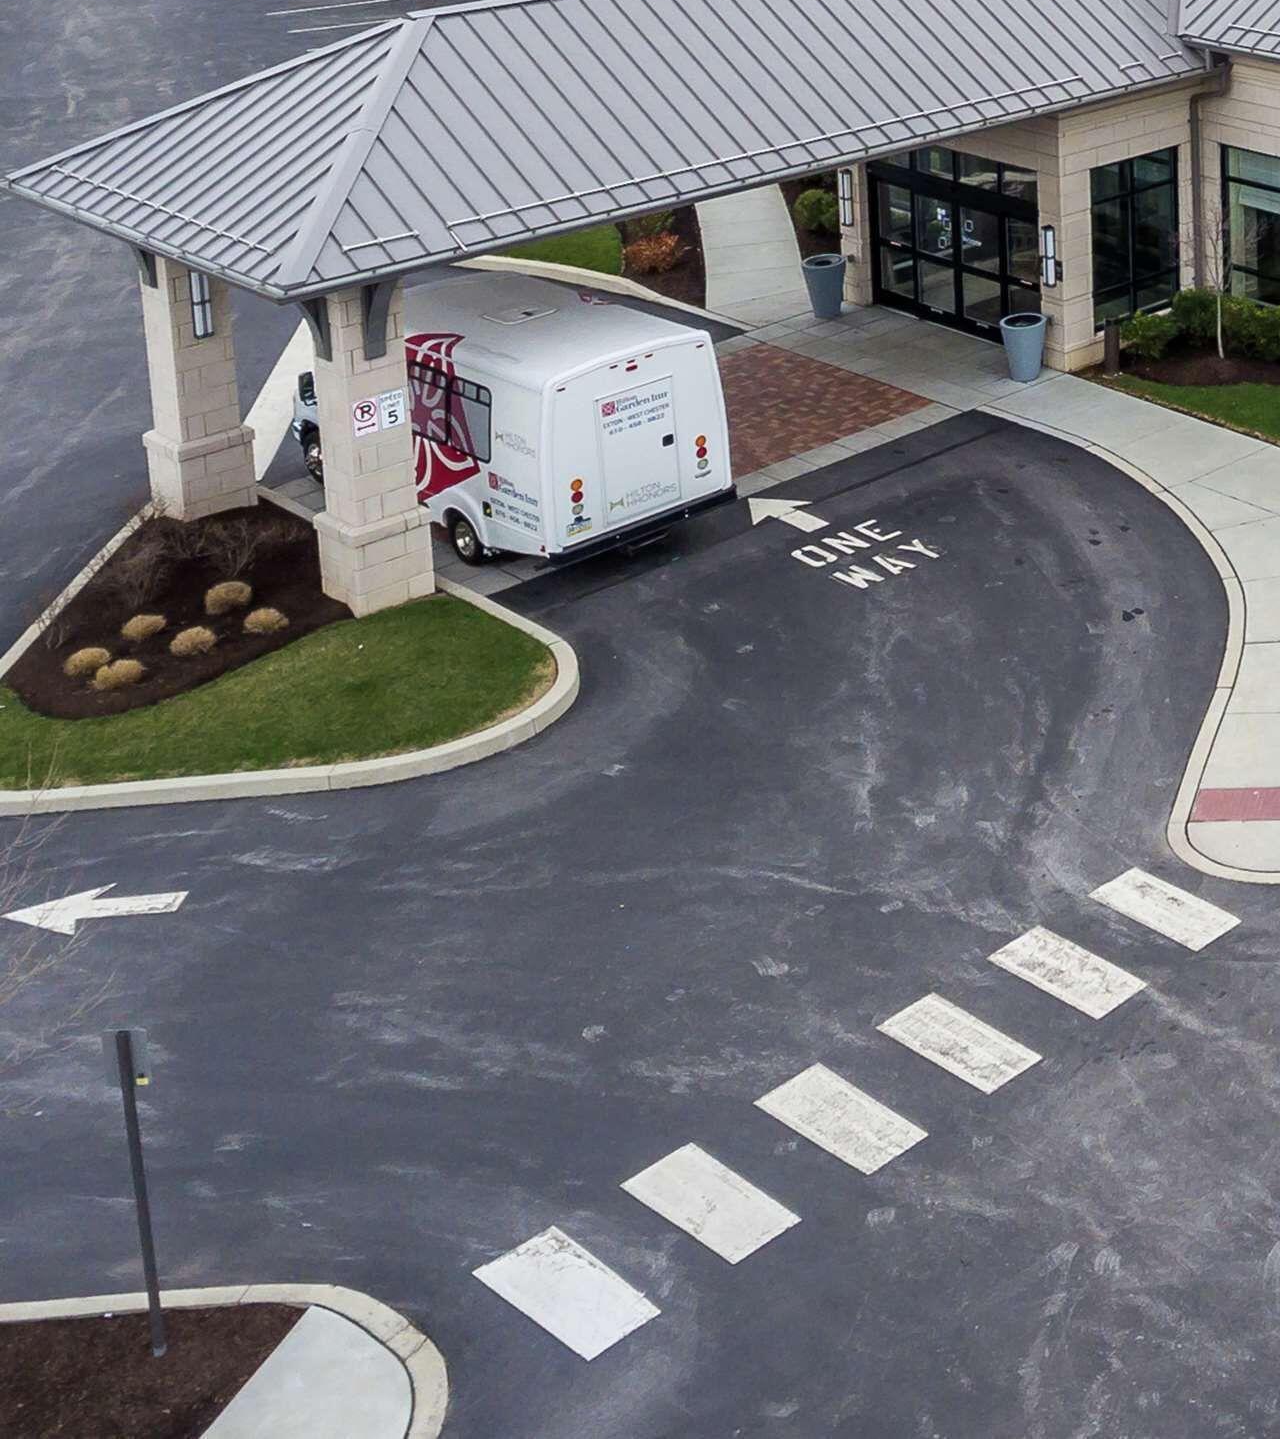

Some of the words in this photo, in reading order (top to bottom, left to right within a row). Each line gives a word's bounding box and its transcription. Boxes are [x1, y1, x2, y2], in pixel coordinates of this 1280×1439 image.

[380, 392, 402, 402] SPEED
[616, 397, 650, 413] Garden
[651, 391, 669, 402] Inn
[388, 409, 399, 424] 5
[791, 519, 903, 568] ONE
[831, 539, 940, 589] WAY
